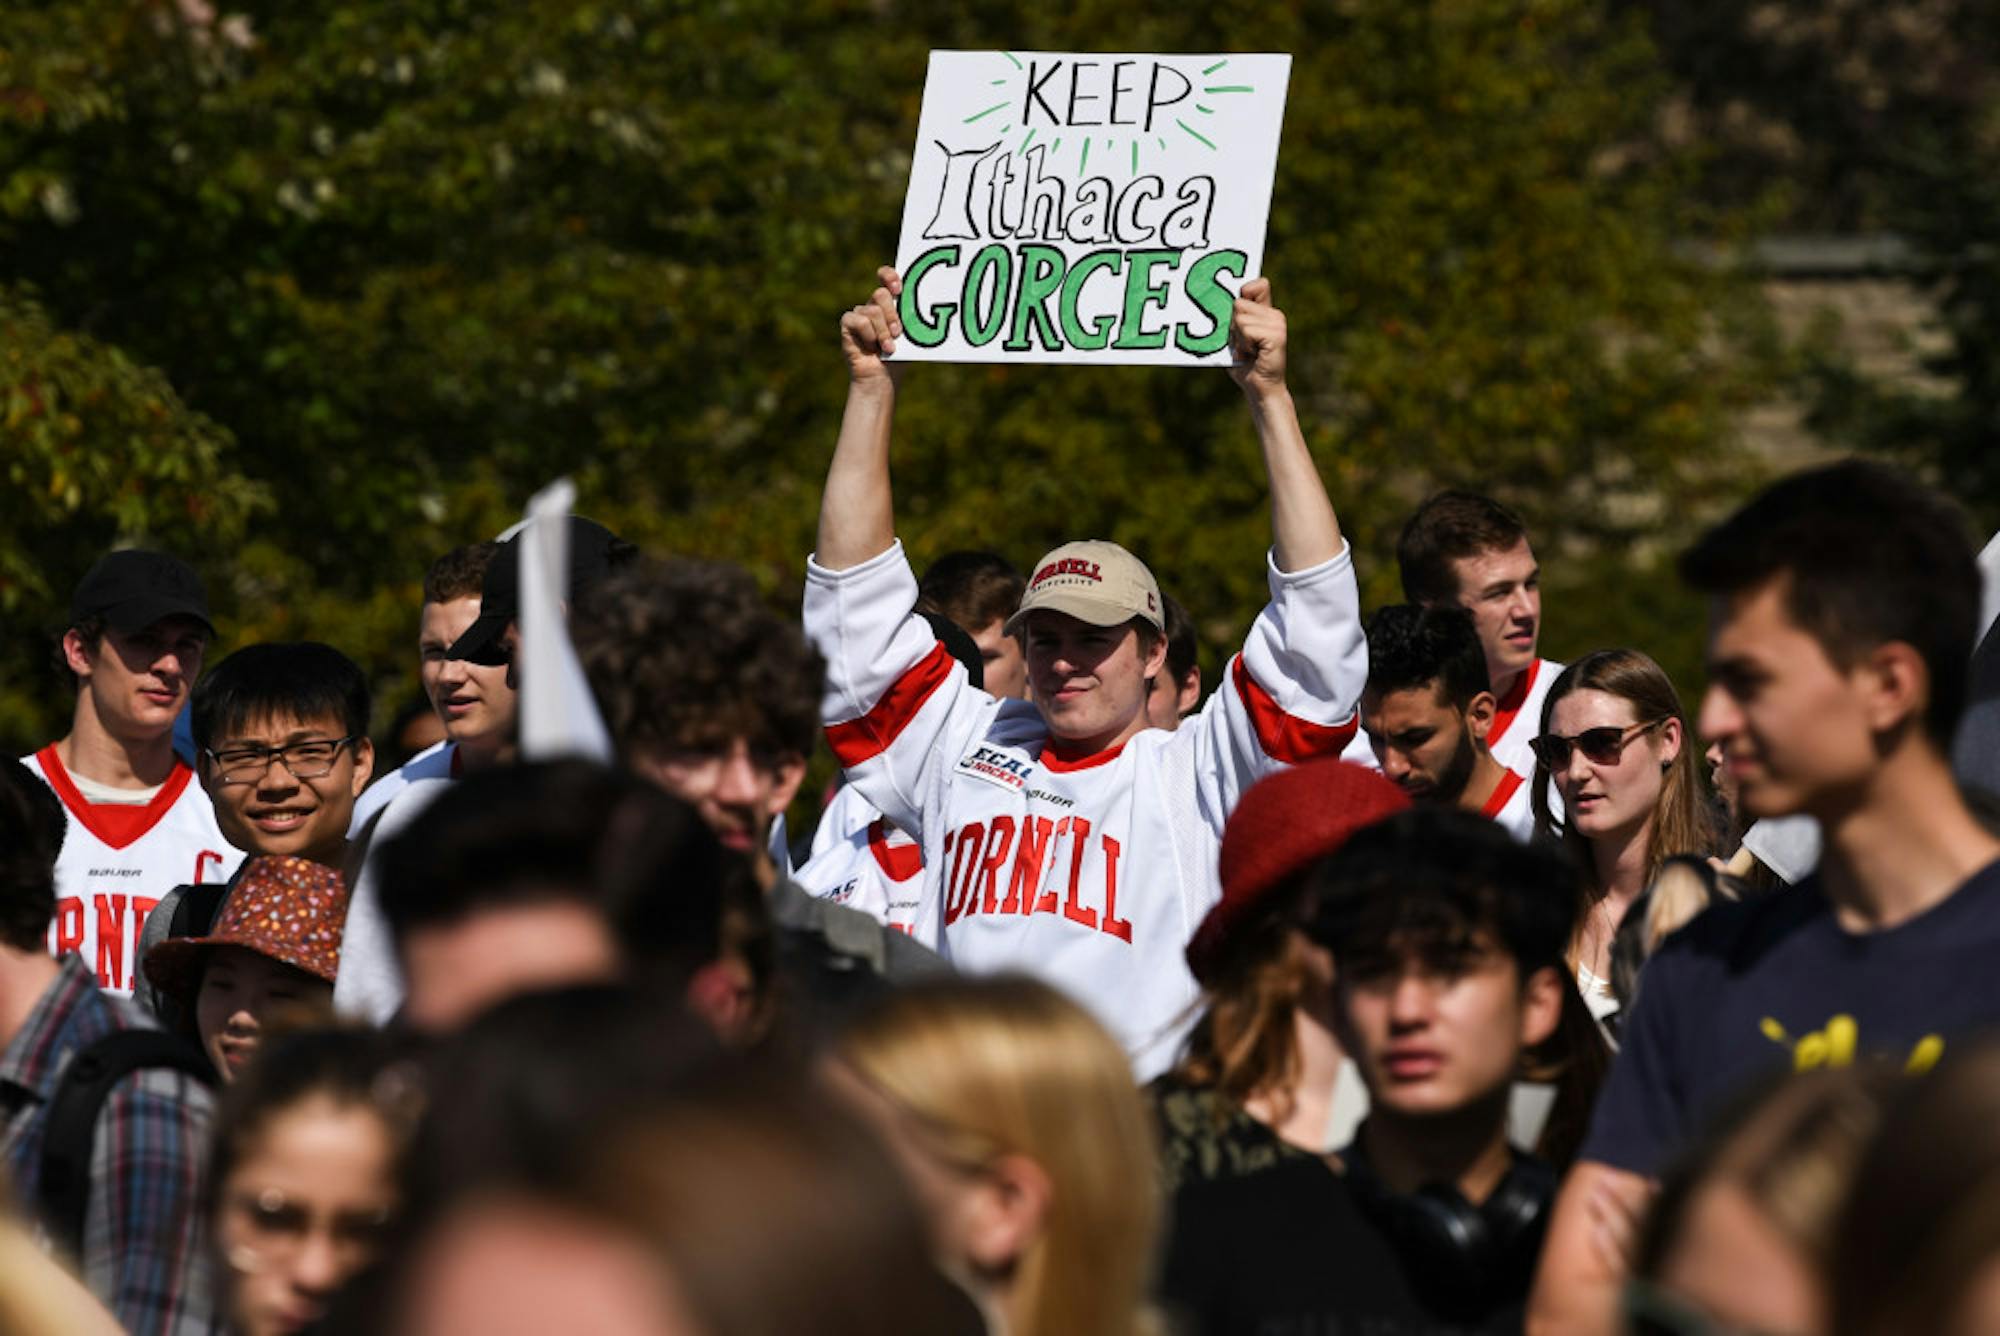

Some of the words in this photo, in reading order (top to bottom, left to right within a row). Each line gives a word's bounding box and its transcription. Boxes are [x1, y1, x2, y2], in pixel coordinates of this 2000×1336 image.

[1022, 60, 1192, 132] KEEP
[922, 140, 1217, 250] Ithaca
[897, 243, 1249, 358] GORGES
